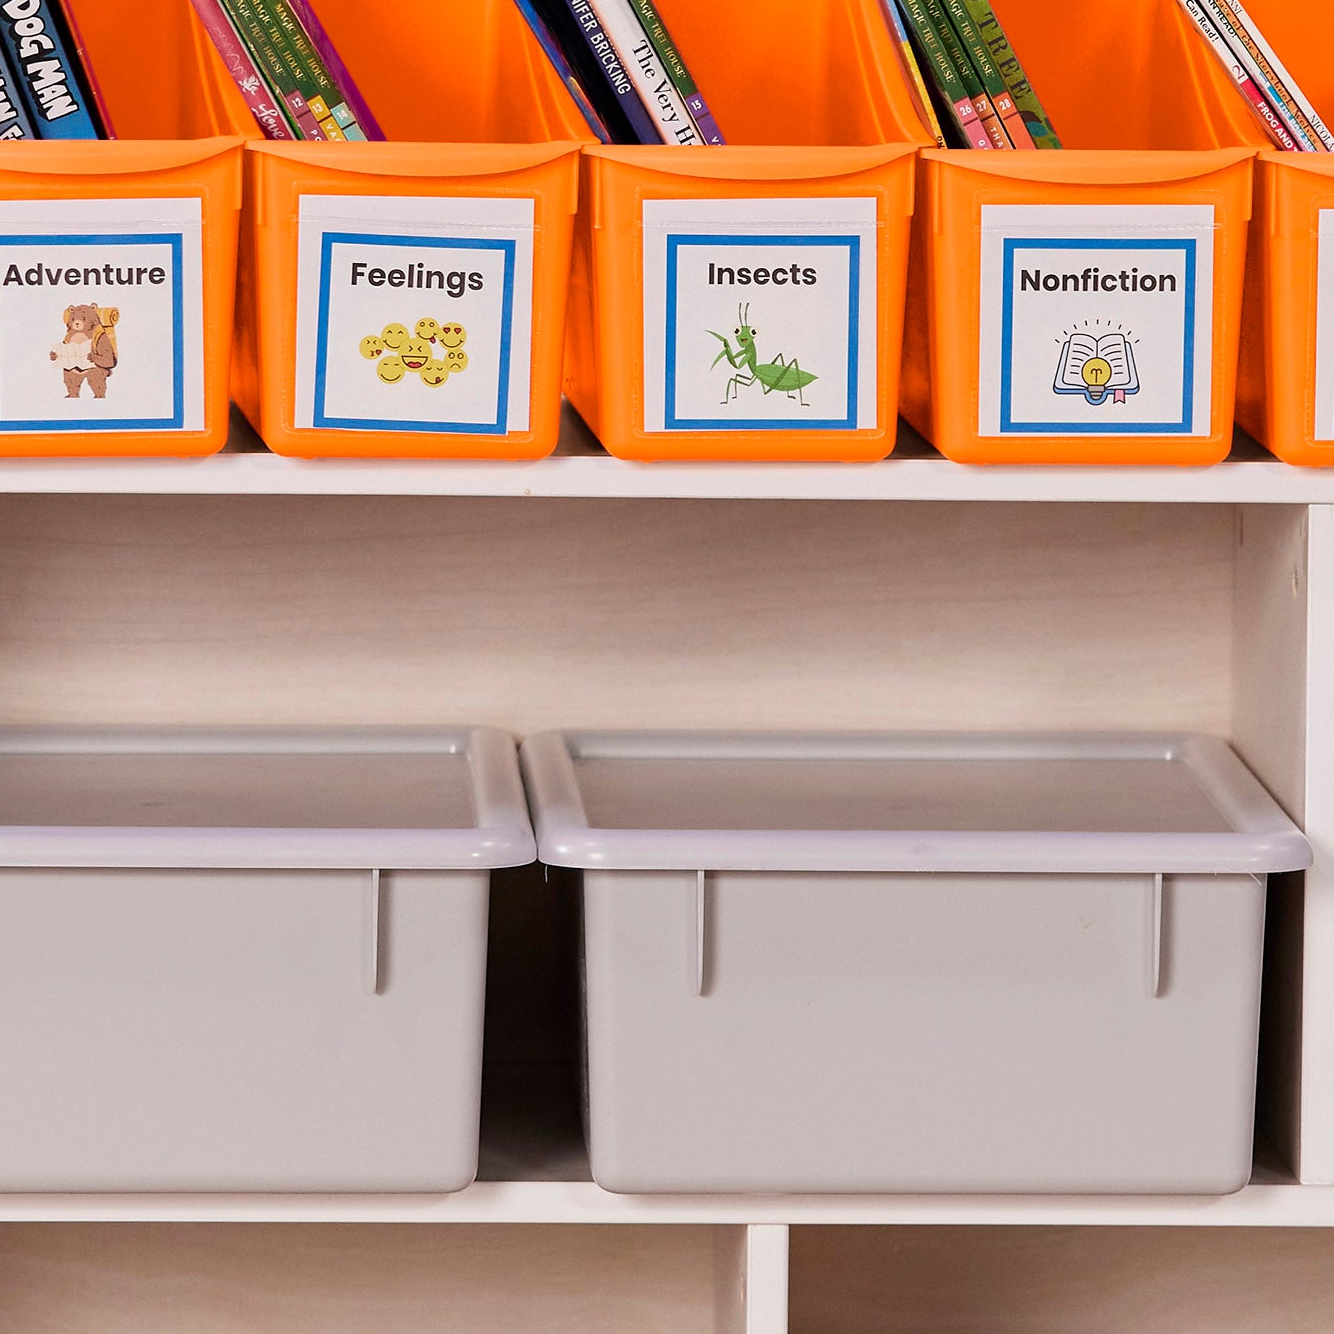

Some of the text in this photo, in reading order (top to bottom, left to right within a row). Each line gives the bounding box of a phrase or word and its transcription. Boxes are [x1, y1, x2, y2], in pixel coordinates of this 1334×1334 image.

[250, 22, 266, 45] TREE
[274, 3, 296, 33] MAGIC
[293, 34, 310, 56] TREE
[961, 20, 978, 45] TREE
[1186, 0, 1199, 17] Can
[1198, 16, 1219, 43] Read!
[269, 26, 285, 49] TREE
[652, 21, 670, 47] TREE
[923, 26, 939, 49] TREE
[590, 28, 631, 96] BRICKING
[977, 11, 1032, 100] TREE
[1232, 64, 1246, 80] 2
[27, 59, 78, 120] MAN
[632, 39, 696, 145] The Very H
[291, 97, 303, 108] 12
[312, 103, 324, 114] 13
[691, 100, 702, 110] 15
[959, 105, 972, 116] 26
[976, 100, 987, 112] 27
[999, 99, 1011, 111] 28
[251, 103, 285, 139] Love
[1257, 101, 1294, 149] FROG AND
[990, 127, 1007, 149] THA
[2, 263, 166, 287] Adventure
[350, 262, 484, 298] Feelings
[708, 263, 817, 285] Insects
[1020, 267, 1176, 292] Nonfiction
